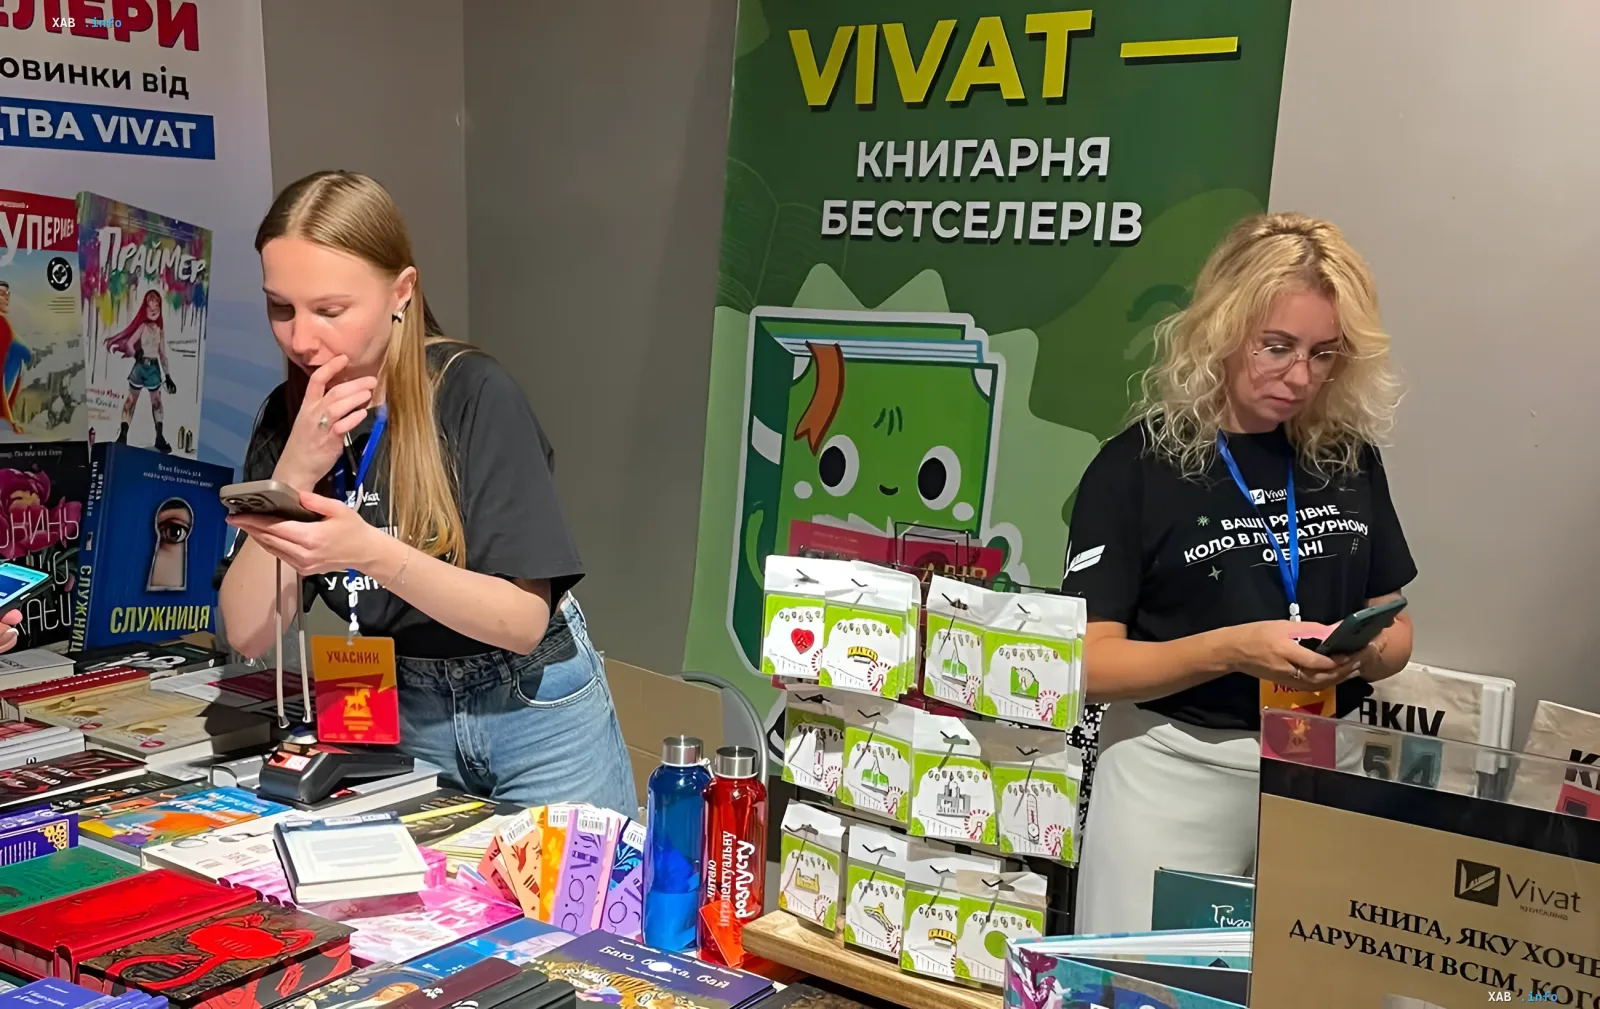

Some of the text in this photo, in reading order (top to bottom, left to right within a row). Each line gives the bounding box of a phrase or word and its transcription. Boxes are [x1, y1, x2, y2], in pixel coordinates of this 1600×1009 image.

[0, 0, 200, 51] ЛЕРИ
[788, 9, 1093, 106] VIVAT
[142, 66, 189, 100] від
[0, 106, 197, 149] ТВА VIVAT
[857, 137, 1110, 178] КНИГАРНЯ
[821, 200, 1143, 243] БЕСТСЕЛЕРІВ
[1184, 536, 1236, 563] КОЛО
[1237, 532, 1251, 546] В
[110, 605, 210, 634] СЛУЖНИЦЯ
[326, 650, 380, 665] УЧАСНИК
[735, 840, 755, 919] розпусту
[1506, 873, 1581, 913] Vivat
[1348, 900, 1452, 945] КНИГА,
[1456, 927, 1519, 957] ЯКУ
[1289, 919, 1436, 971] ДАРУВАТИ
[1439, 955, 1524, 998] ВСІМ,
